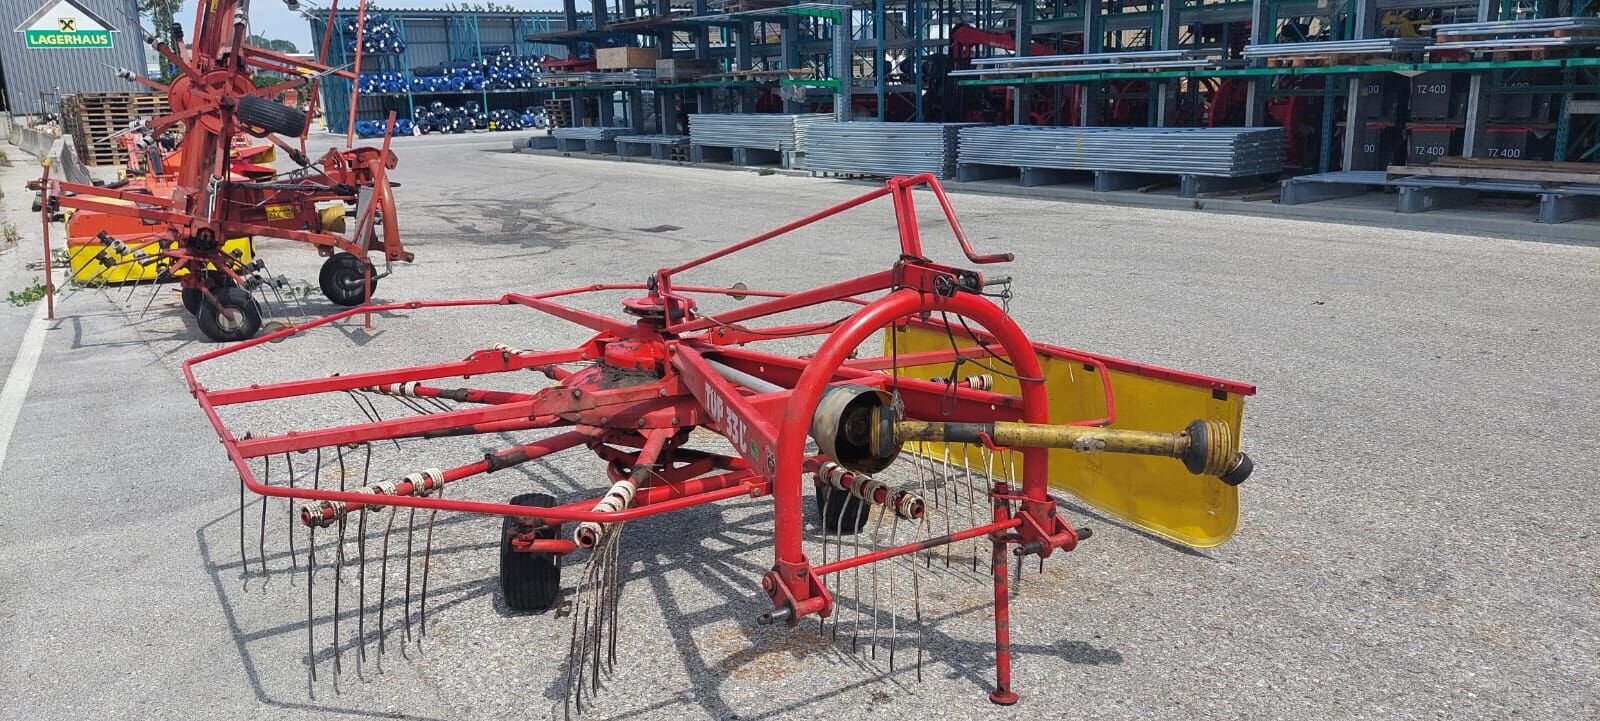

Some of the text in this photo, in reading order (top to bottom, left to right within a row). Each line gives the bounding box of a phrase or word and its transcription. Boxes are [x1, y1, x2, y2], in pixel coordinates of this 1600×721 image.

[30, 34, 108, 45] LAGERHAUS
[1417, 84, 1446, 94] TZ 400
[1415, 146, 1445, 156] TZ 400
[1487, 148, 1521, 158] TZ 400
